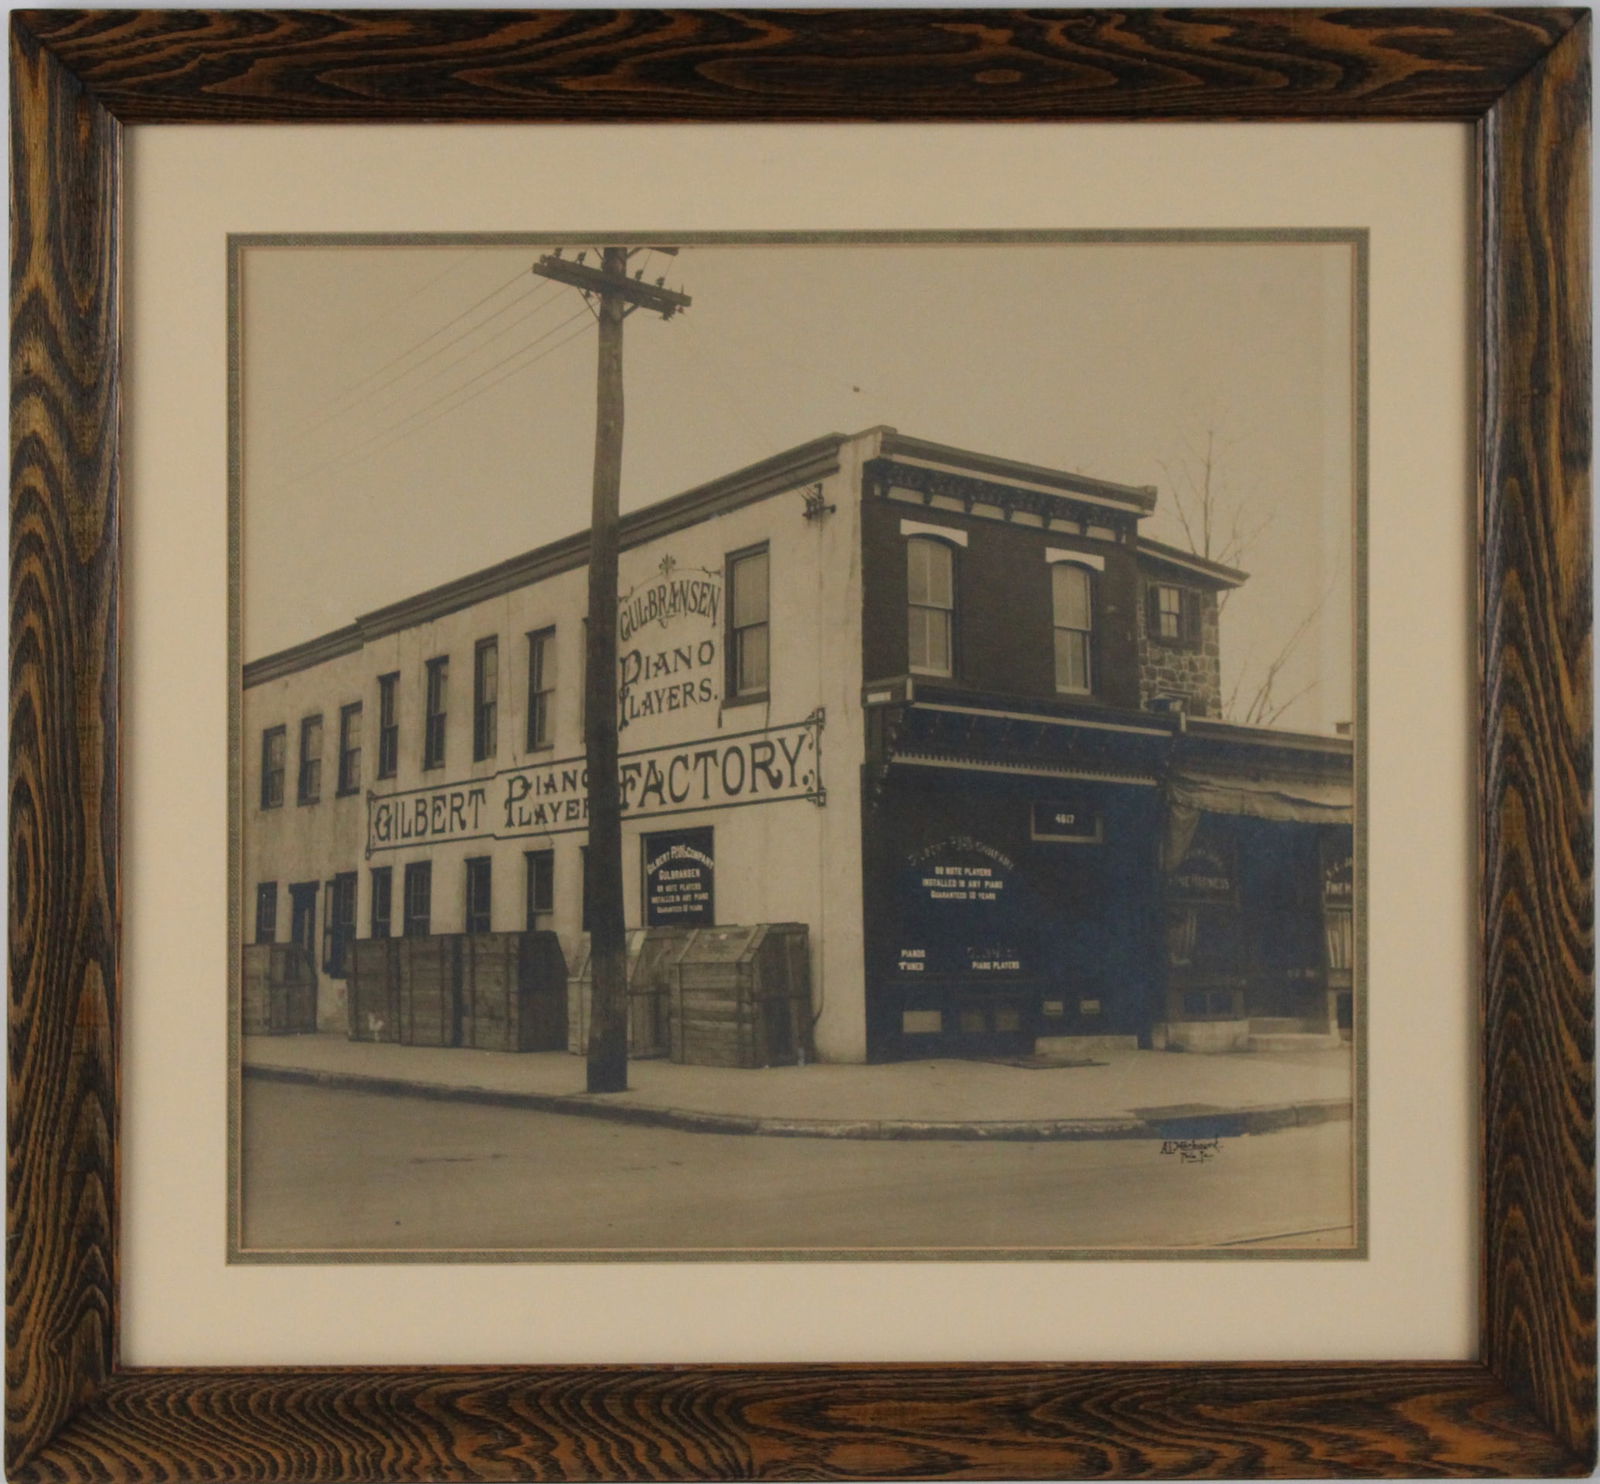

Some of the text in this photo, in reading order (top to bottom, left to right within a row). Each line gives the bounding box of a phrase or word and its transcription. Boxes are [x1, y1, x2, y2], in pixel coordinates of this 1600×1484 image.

[619, 578, 722, 643] GULBRANSEN
[618, 639, 715, 690] PIANO
[374, 788, 487, 842] GILBERT
